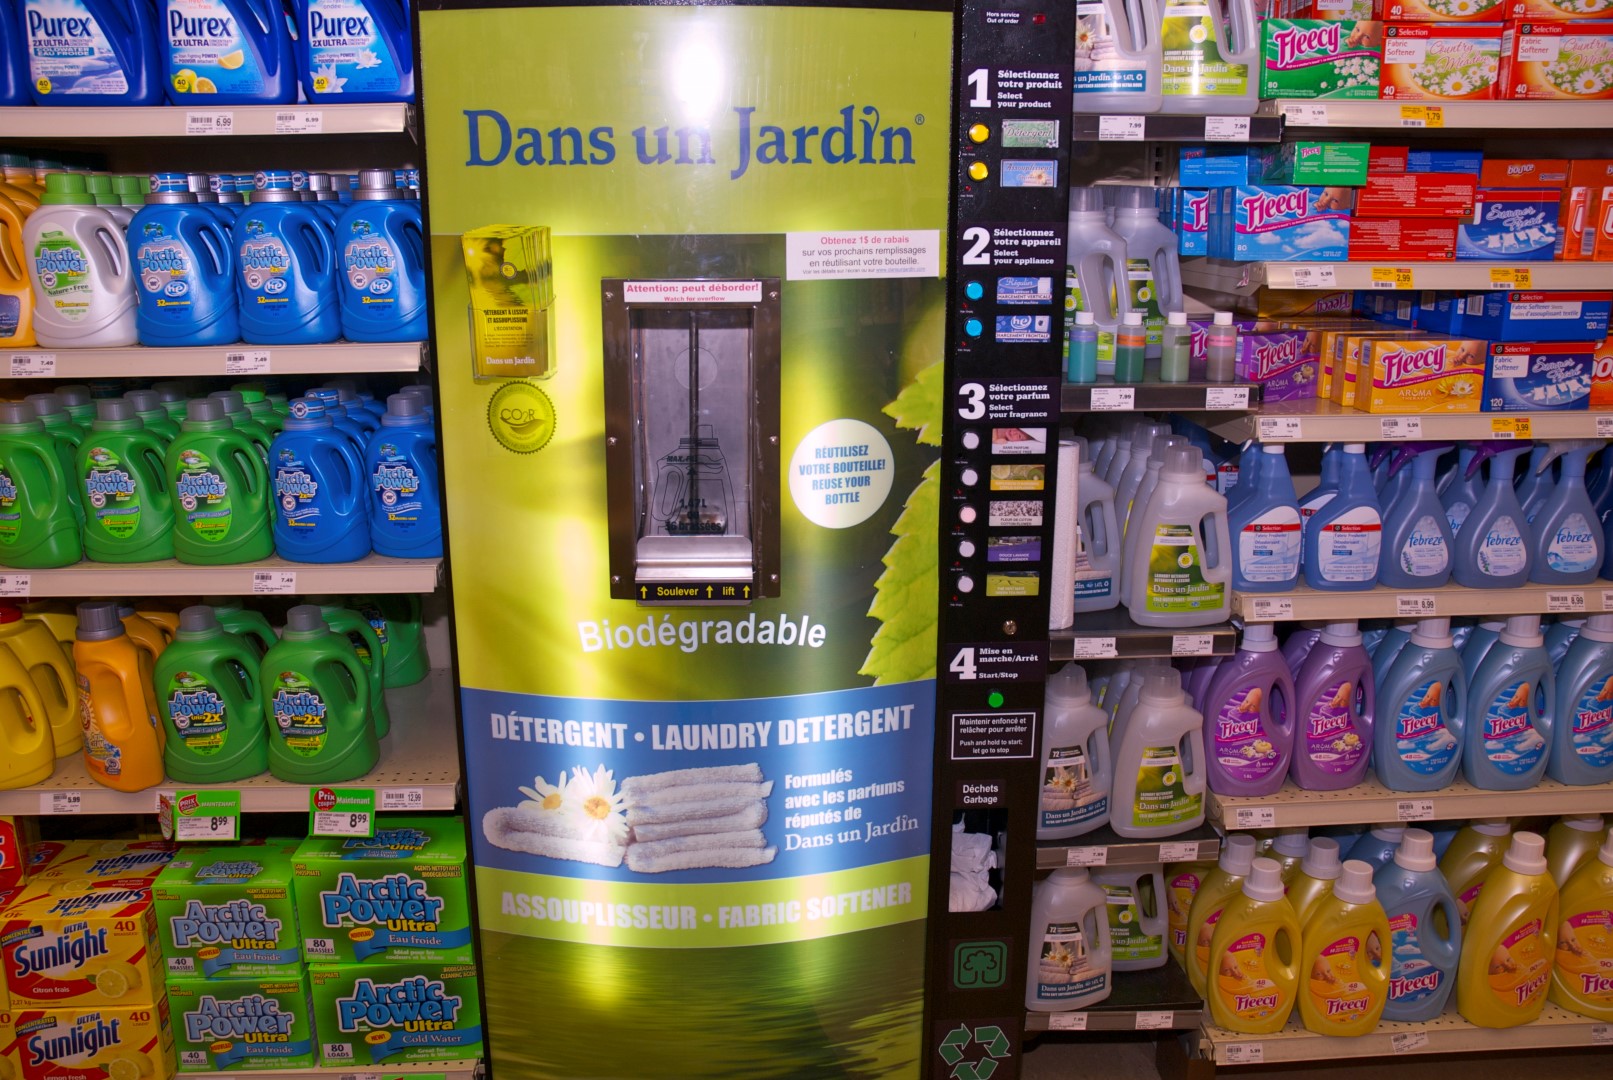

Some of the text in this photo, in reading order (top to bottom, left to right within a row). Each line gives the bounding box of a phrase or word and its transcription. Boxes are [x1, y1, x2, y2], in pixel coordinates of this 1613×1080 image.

[28, 10, 92, 38] Purex
[170, 10, 232, 38] Purex
[1398, 28, 1429, 36] Selection
[43, 39, 70, 47] ULTRA
[1274, 22, 1341, 68] Fleecy
[1387, 40, 1408, 48] Fabric
[1387, 48, 1416, 57] Softener
[998, 70, 1060, 79] Sélectionnez
[968, 68, 991, 108] 1
[1026, 80, 1063, 90] produit
[997, 92, 1023, 100] Select
[1018, 100, 1052, 109] product
[463, 109, 616, 167] Dans
[633, 124, 716, 166] un
[1507, 164, 1535, 175] bounce
[1242, 188, 1310, 232] Fleecy
[994, 228, 1054, 237] Sélectionnez
[820, 235, 909, 245] Obtenez 1$ de rabais
[962, 226, 990, 265] 2
[994, 238, 1061, 247] votre appareil
[41, 247, 80, 261] Arctic
[834, 247, 873, 258] prochains
[875, 246, 926, 257] remplissages
[35, 257, 88, 274] Power
[822, 258, 861, 267] réutilisant
[863, 258, 882, 266] votre
[1014, 257, 1054, 265] appliance
[626, 283, 759, 293] Attention: peut déborder!
[1256, 335, 1298, 379] Fleecy
[1494, 356, 1512, 364] Fabric
[1382, 344, 1447, 387] Fleecy
[989, 384, 1047, 392] Sélectionnez
[958, 383, 985, 420] 3
[1016, 392, 1050, 401] parfum
[815, 445, 869, 459] RÉUTILISEZ
[799, 459, 886, 476] VOTRE BOUTEILLE!
[90, 470, 128, 484] Arctic
[812, 476, 871, 490] REUSE YOUR
[85, 480, 135, 495] Power
[825, 492, 860, 505] BOTTLE
[1409, 530, 1443, 547] febreze
[1556, 527, 1593, 546] febreze
[657, 586, 735, 596] Soulever lift
[1153, 584, 1174, 593] Dans
[1187, 584, 1210, 594] Jardin
[577, 614, 826, 653] Biodégradable
[950, 648, 977, 680] 4
[979, 655, 1038, 663] marche/Arrêt
[279, 691, 319, 705] Arctic
[273, 701, 326, 718] Power
[304, 714, 321, 725] 2X
[960, 718, 990, 726] Maintenir
[992, 717, 1019, 725] enfoncé
[1401, 712, 1438, 735] Fleecy
[491, 704, 914, 751] DÉTERGENT LAUNDRY DETERGENT
[960, 726, 987, 734] relâcher
[988, 727, 1003, 735] pour
[1220, 718, 1258, 739] Fleecy
[785, 769, 852, 789] Formulés
[318, 790, 335, 801] Prix
[785, 779, 905, 809] avec les parfums
[962, 784, 999, 794] Déchets
[963, 795, 998, 804] Garbage
[785, 808, 862, 831] réputés de
[785, 814, 919, 852] Dans un Jardin
[339, 874, 426, 900] Arctic
[188, 900, 265, 922] Arctic
[323, 893, 441, 925] Power
[502, 882, 912, 930] ASSOUPLISSEUR FABRIC SOFTENER
[64, 921, 88, 935] ULTRA
[114, 920, 136, 932] 40
[173, 917, 279, 945] Power
[386, 919, 437, 932] Ultra
[231, 938, 276, 950] Ultra
[389, 935, 442, 945] Eau froide
[15, 927, 108, 977] Sunlight
[356, 976, 443, 1005] Arctic
[1389, 971, 1439, 1000] Fleecy
[1235, 994, 1278, 1012] Fleecy
[339, 998, 458, 1030] Power
[404, 1019, 454, 1032] Ultra
[29, 1018, 121, 1065] Sunlight
[403, 1034, 461, 1043] Cold Water
[331, 1044, 344, 1052] 80
